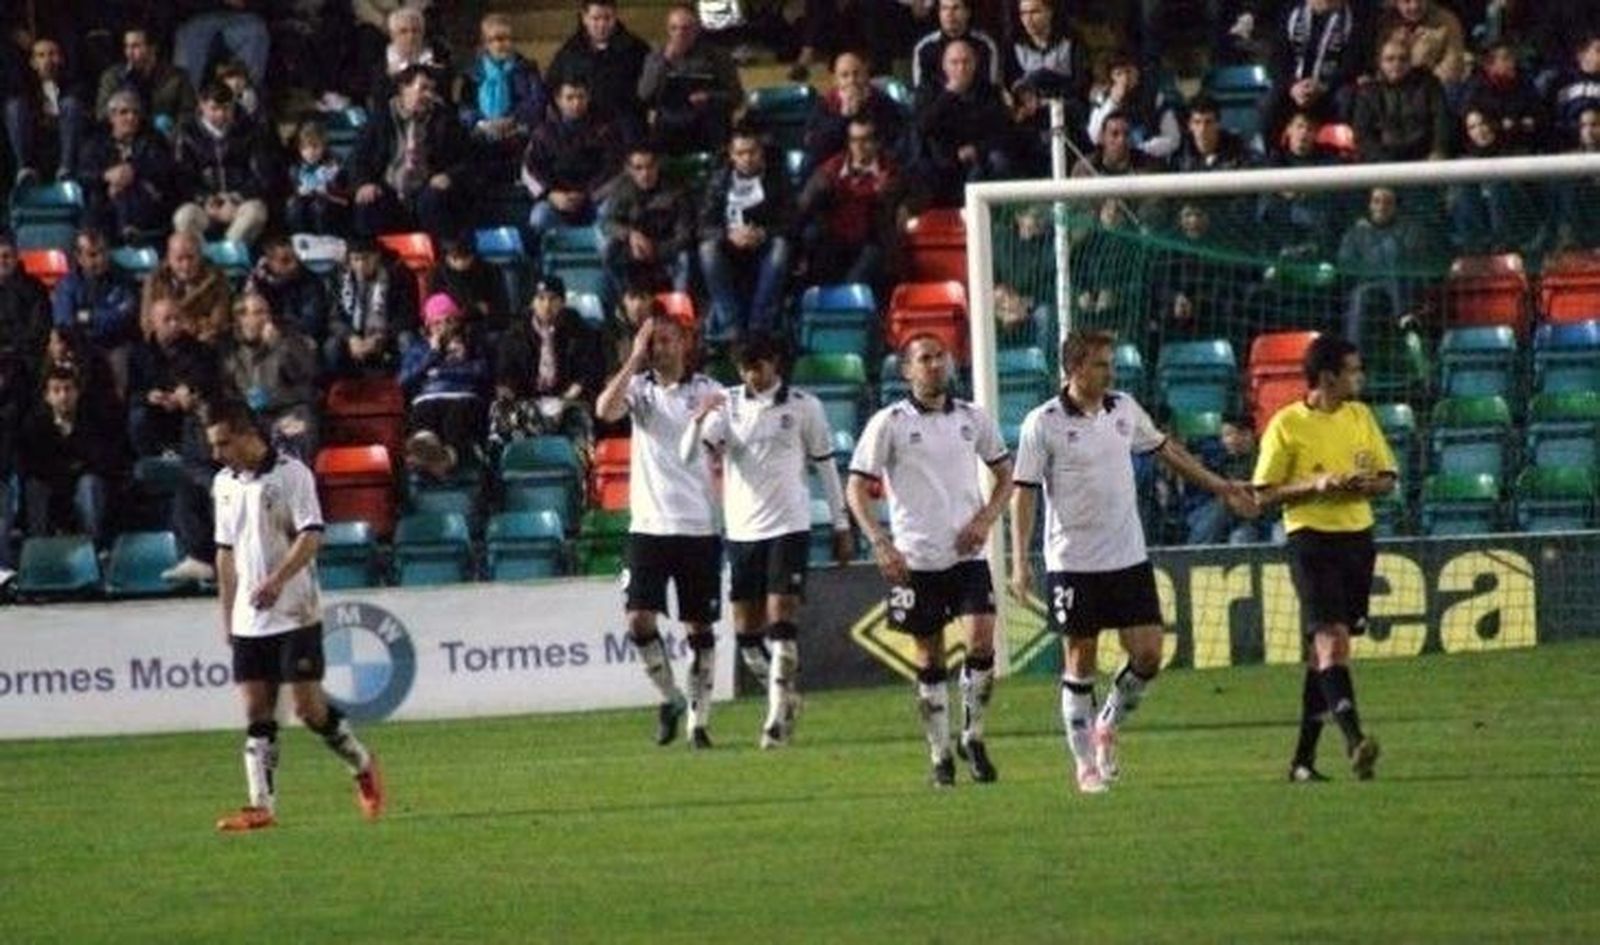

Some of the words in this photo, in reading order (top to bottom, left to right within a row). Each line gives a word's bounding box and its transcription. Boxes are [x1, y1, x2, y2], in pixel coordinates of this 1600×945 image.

[890, 586, 915, 609] 20
[1053, 586, 1075, 610] 21
[440, 641, 591, 673] Tormes
[130, 657, 230, 690] Moto
